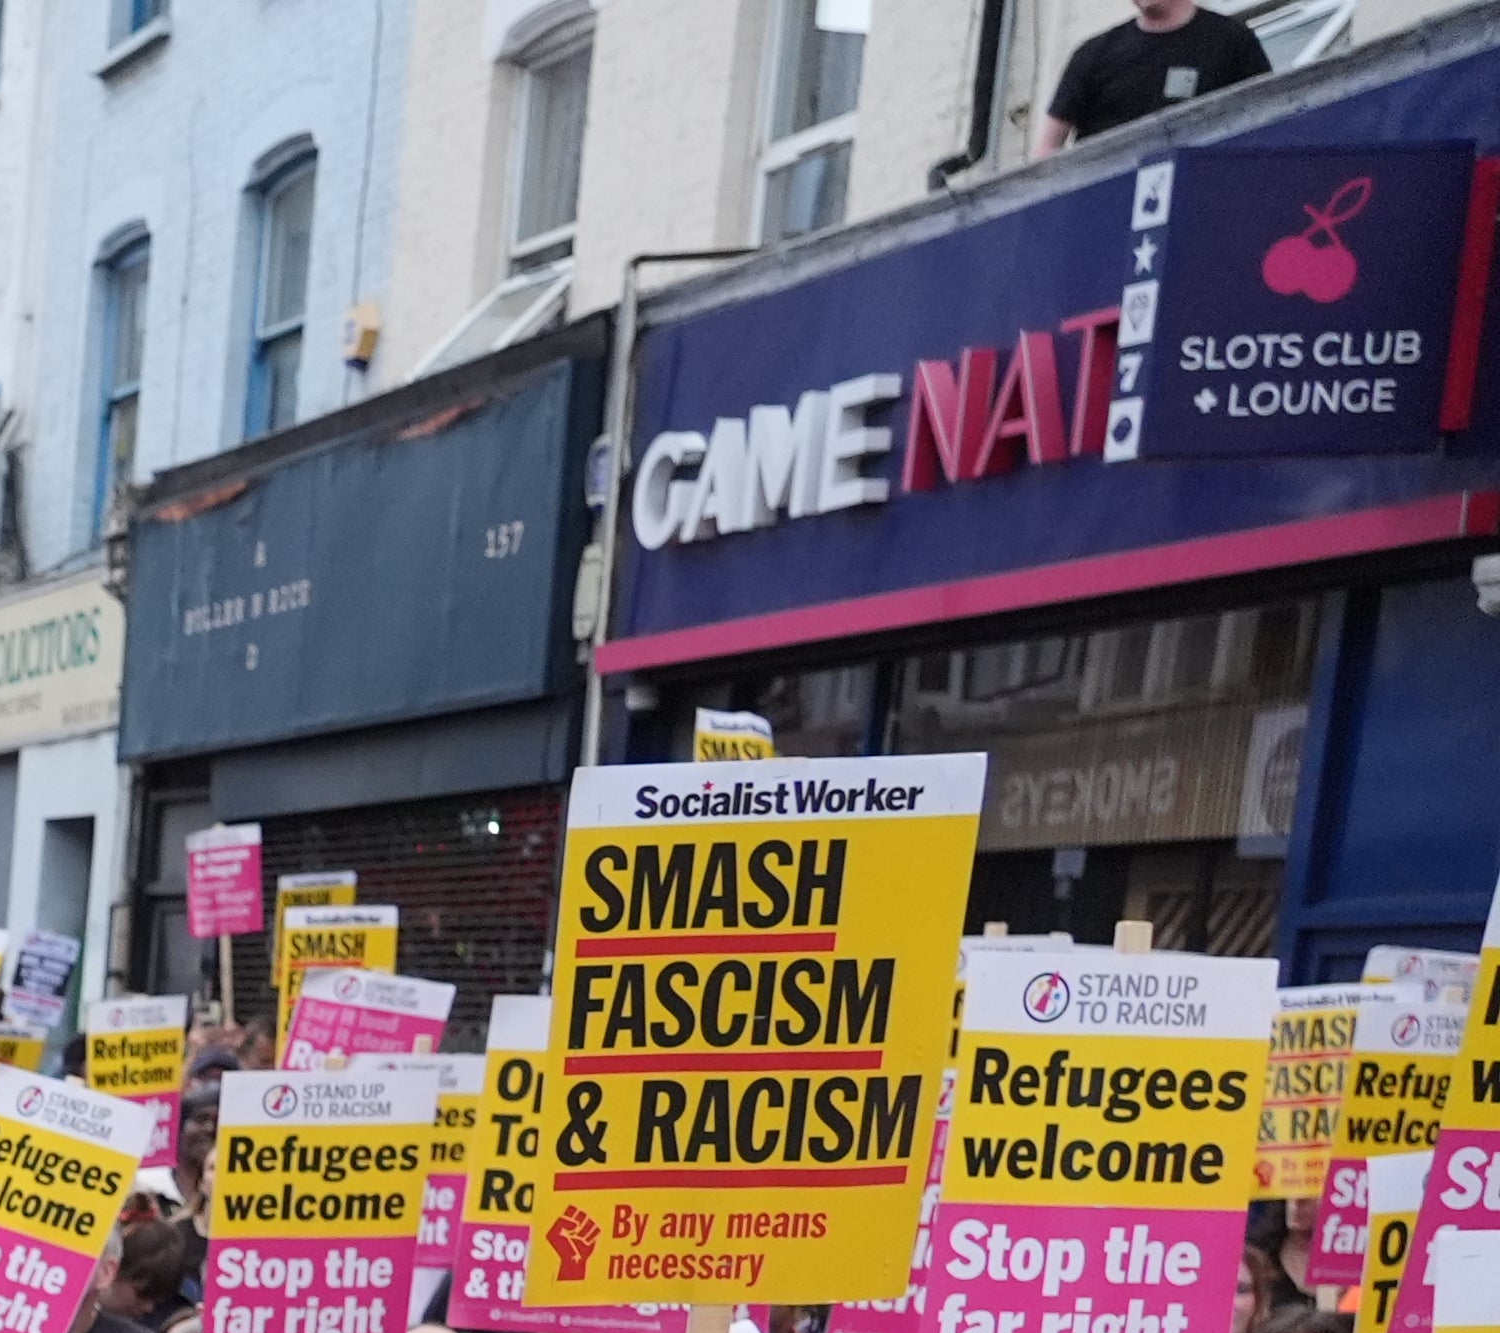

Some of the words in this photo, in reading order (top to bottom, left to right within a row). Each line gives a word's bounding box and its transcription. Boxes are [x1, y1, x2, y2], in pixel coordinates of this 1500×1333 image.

[1179, 334, 1305, 372] SLOTS
[1312, 329, 1422, 365] CLUB
[1227, 377, 1397, 418] LOUNGE
[484, 521, 525, 559] 157
[579, 838, 848, 934] SMASH
[567, 957, 896, 1051] FASCISM
[93, 1035, 180, 1065] Refugees
[93, 1064, 175, 1089] welcome
[968, 1047, 1247, 1124] Refugees
[555, 1078, 608, 1166] &
[634, 1075, 922, 1164] RACISM
[226, 1136, 420, 1181] Refugees
[963, 1124, 1225, 1184] welcome
[224, 1184, 407, 1222] welcome
[945, 1218, 1086, 1297] Stop
[1103, 1224, 1201, 1287] the
